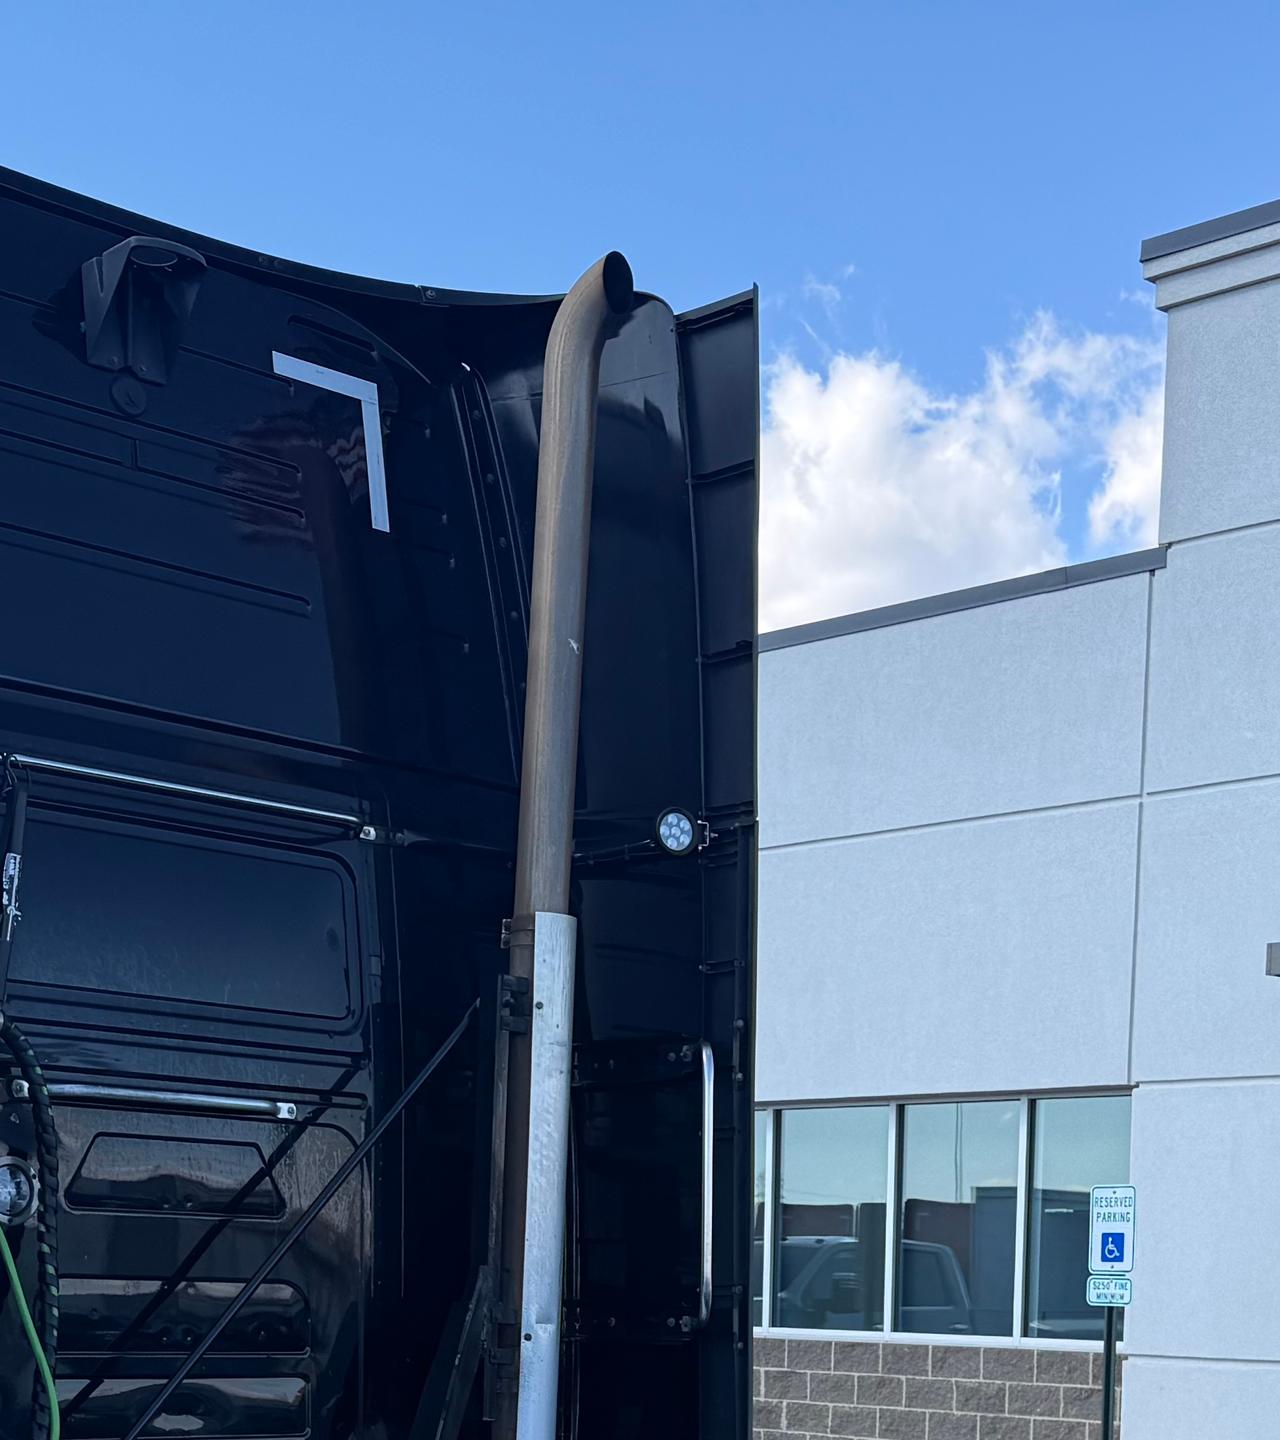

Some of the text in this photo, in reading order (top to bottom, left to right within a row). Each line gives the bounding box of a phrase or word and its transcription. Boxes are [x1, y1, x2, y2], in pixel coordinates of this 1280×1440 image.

[1095, 1196, 1133, 1208] RESERVED
[1096, 1211, 1131, 1223] PARKING
[1092, 1281, 1129, 1291] $250 FINE
[1095, 1292, 1126, 1301] MINMUM
